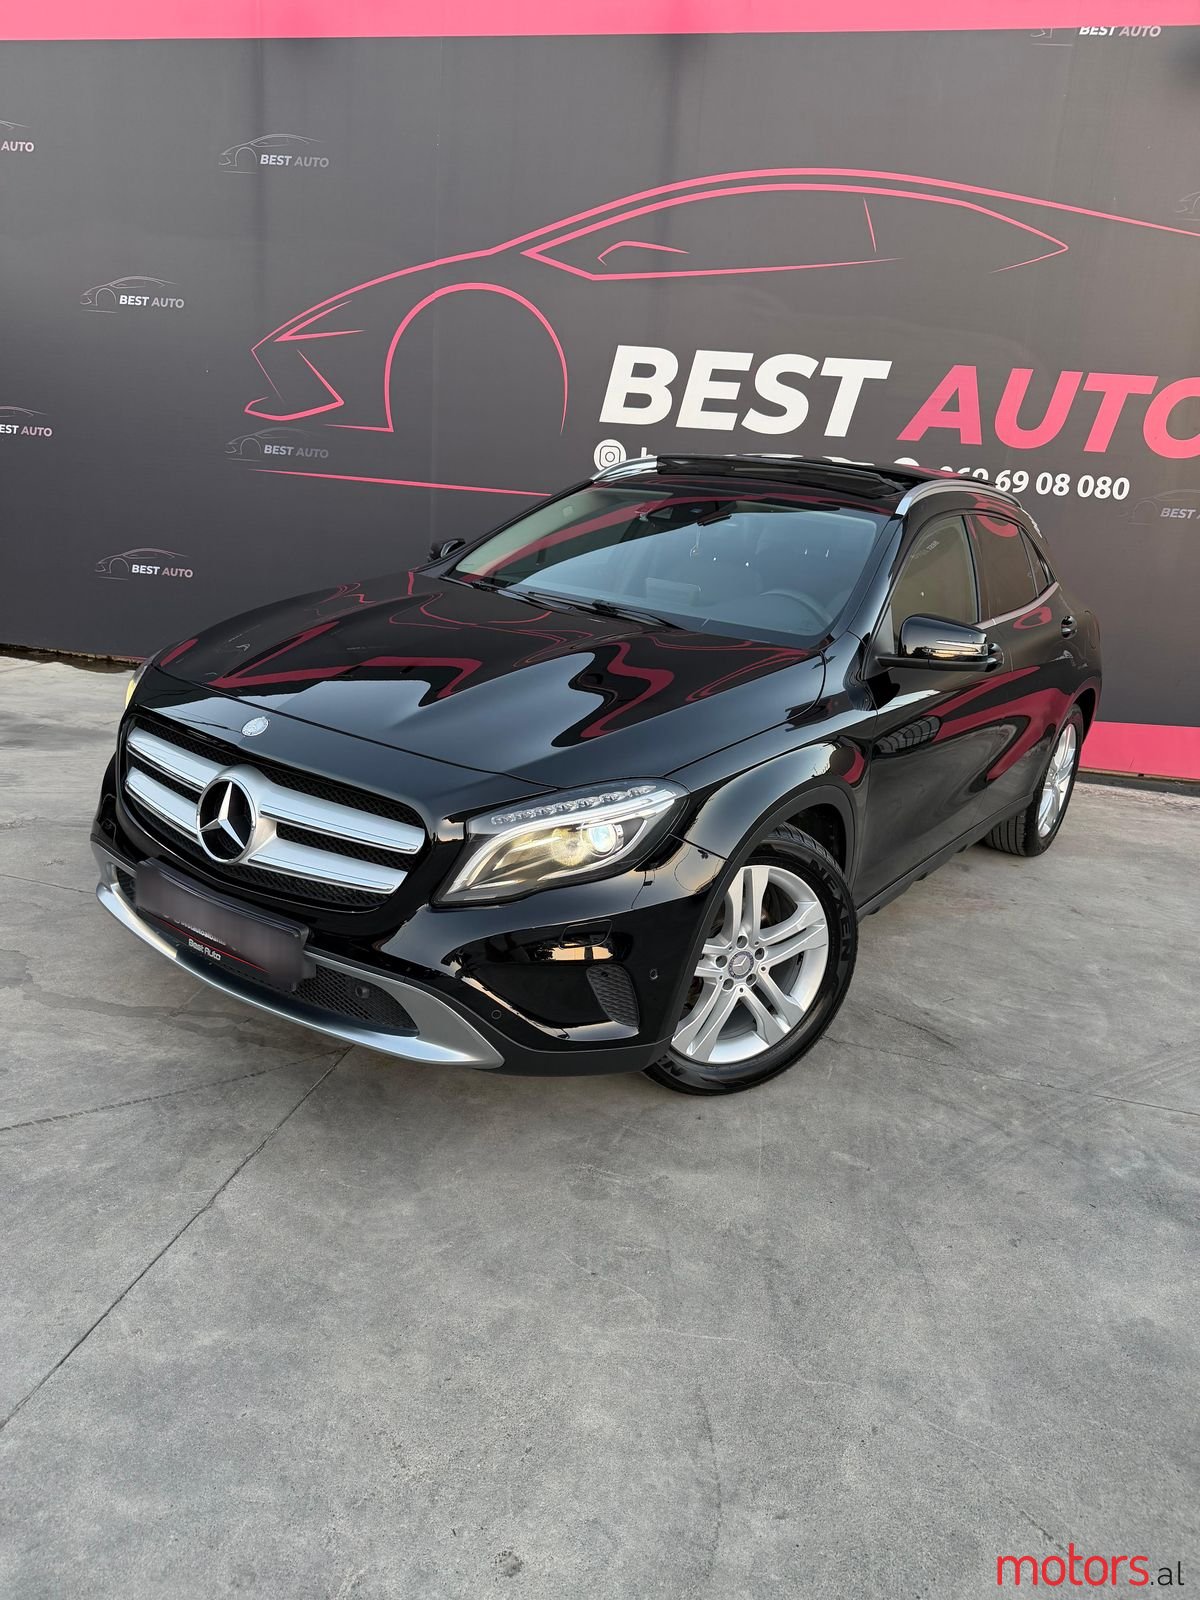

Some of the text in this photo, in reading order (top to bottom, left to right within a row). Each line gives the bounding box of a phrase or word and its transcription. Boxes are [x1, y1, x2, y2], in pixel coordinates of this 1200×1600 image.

[1079, 26, 1161, 37] BEST AUTO
[1, 140, 34, 152] AUTO
[260, 154, 329, 168] BEST AUTO
[119, 295, 185, 308] BEST AUTO
[599, 344, 1200, 459] BEST AUTO
[20, 426, 53, 437] AUTO
[264, 444, 329, 459] BEST AUTO
[995, 469, 1030, 493] 69
[1035, 472, 1071, 497] 08
[1077, 475, 1130, 500] 080
[1160, 507, 1196, 519] BEST
[131, 564, 193, 578] BEST AUTO
[809, 859, 851, 961] NEXEN
[188, 938, 221, 961] Best Auto
